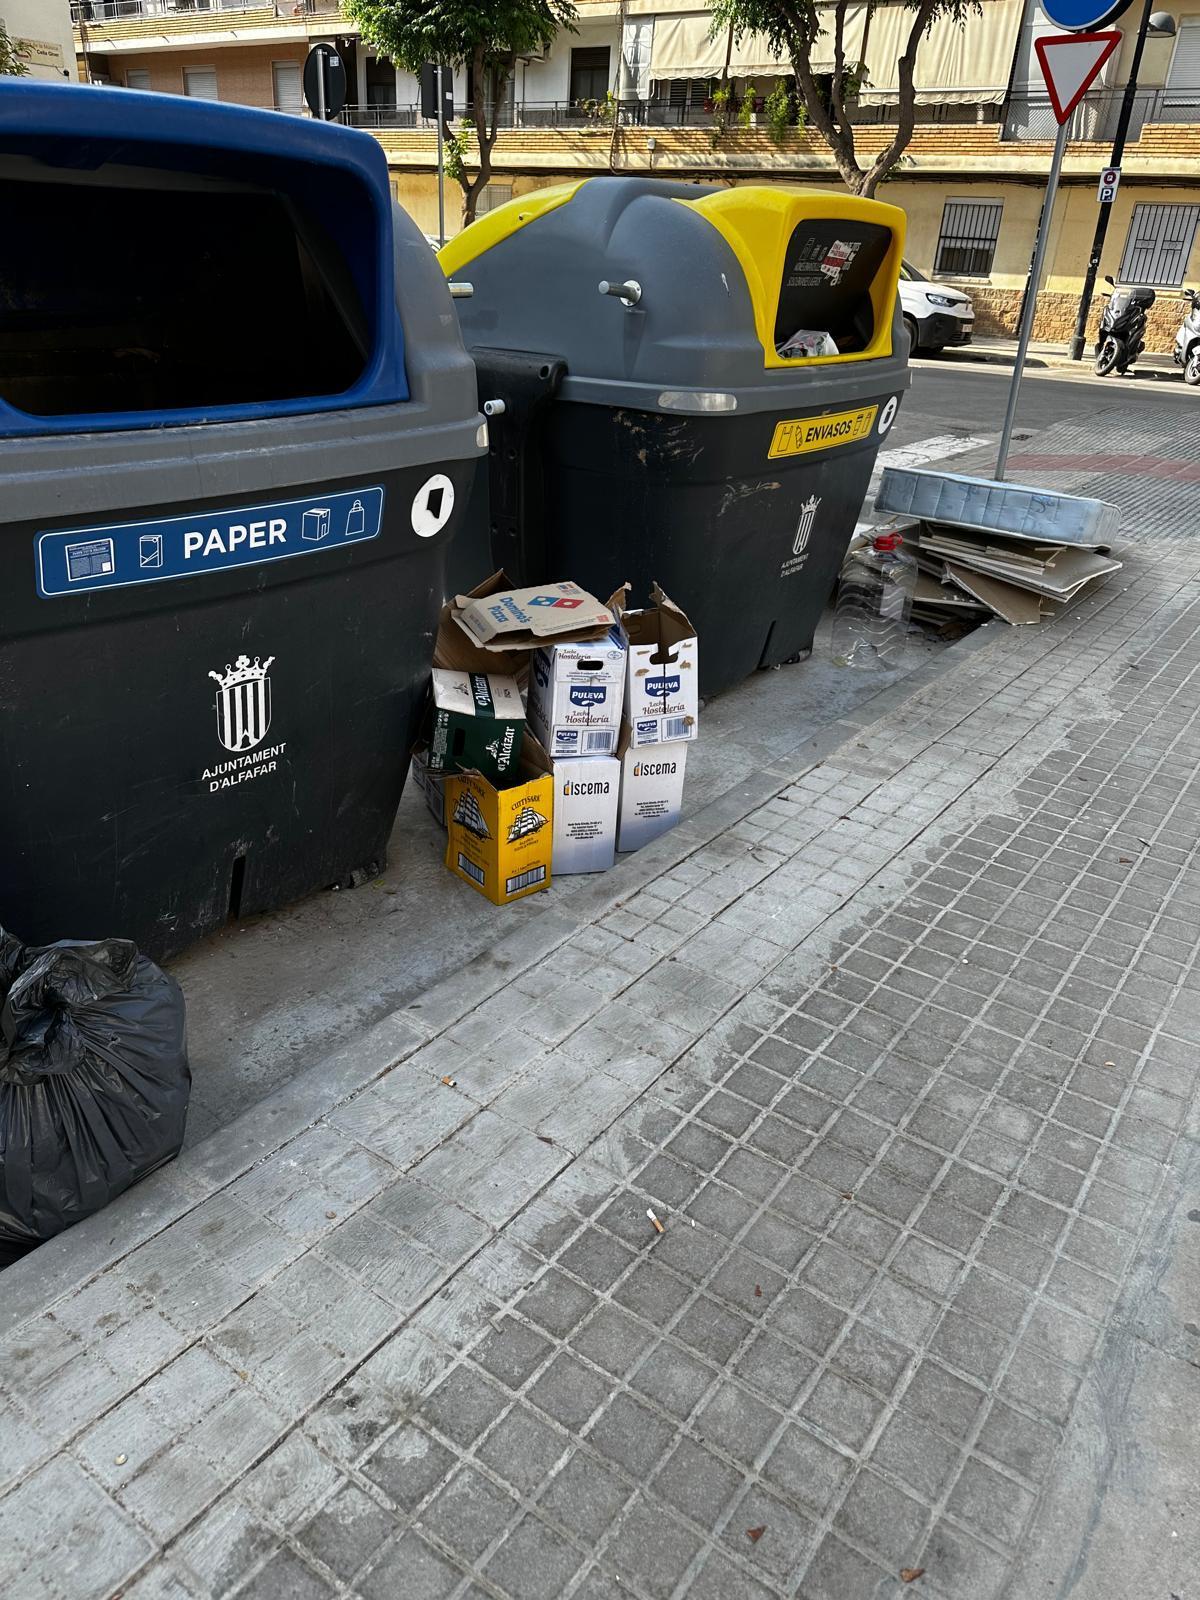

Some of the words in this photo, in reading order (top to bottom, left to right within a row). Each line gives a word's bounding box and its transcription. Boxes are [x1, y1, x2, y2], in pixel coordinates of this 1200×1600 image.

[1102, 189, 1112, 200] P
[804, 419, 853, 443] ENVASOS
[183, 517, 288, 560] PAPER
[487, 605, 510, 624] Pizza
[499, 596, 533, 625] Domino's
[571, 691, 605, 699] PULEVA
[564, 714, 610, 724] Hostelería
[497, 726, 515, 765] Alcázar
[201, 742, 287, 781] AJUNTAMENT
[633, 761, 678, 777] discema
[209, 760, 277, 793] D'ALFAFAR
[563, 780, 610, 796] discema
